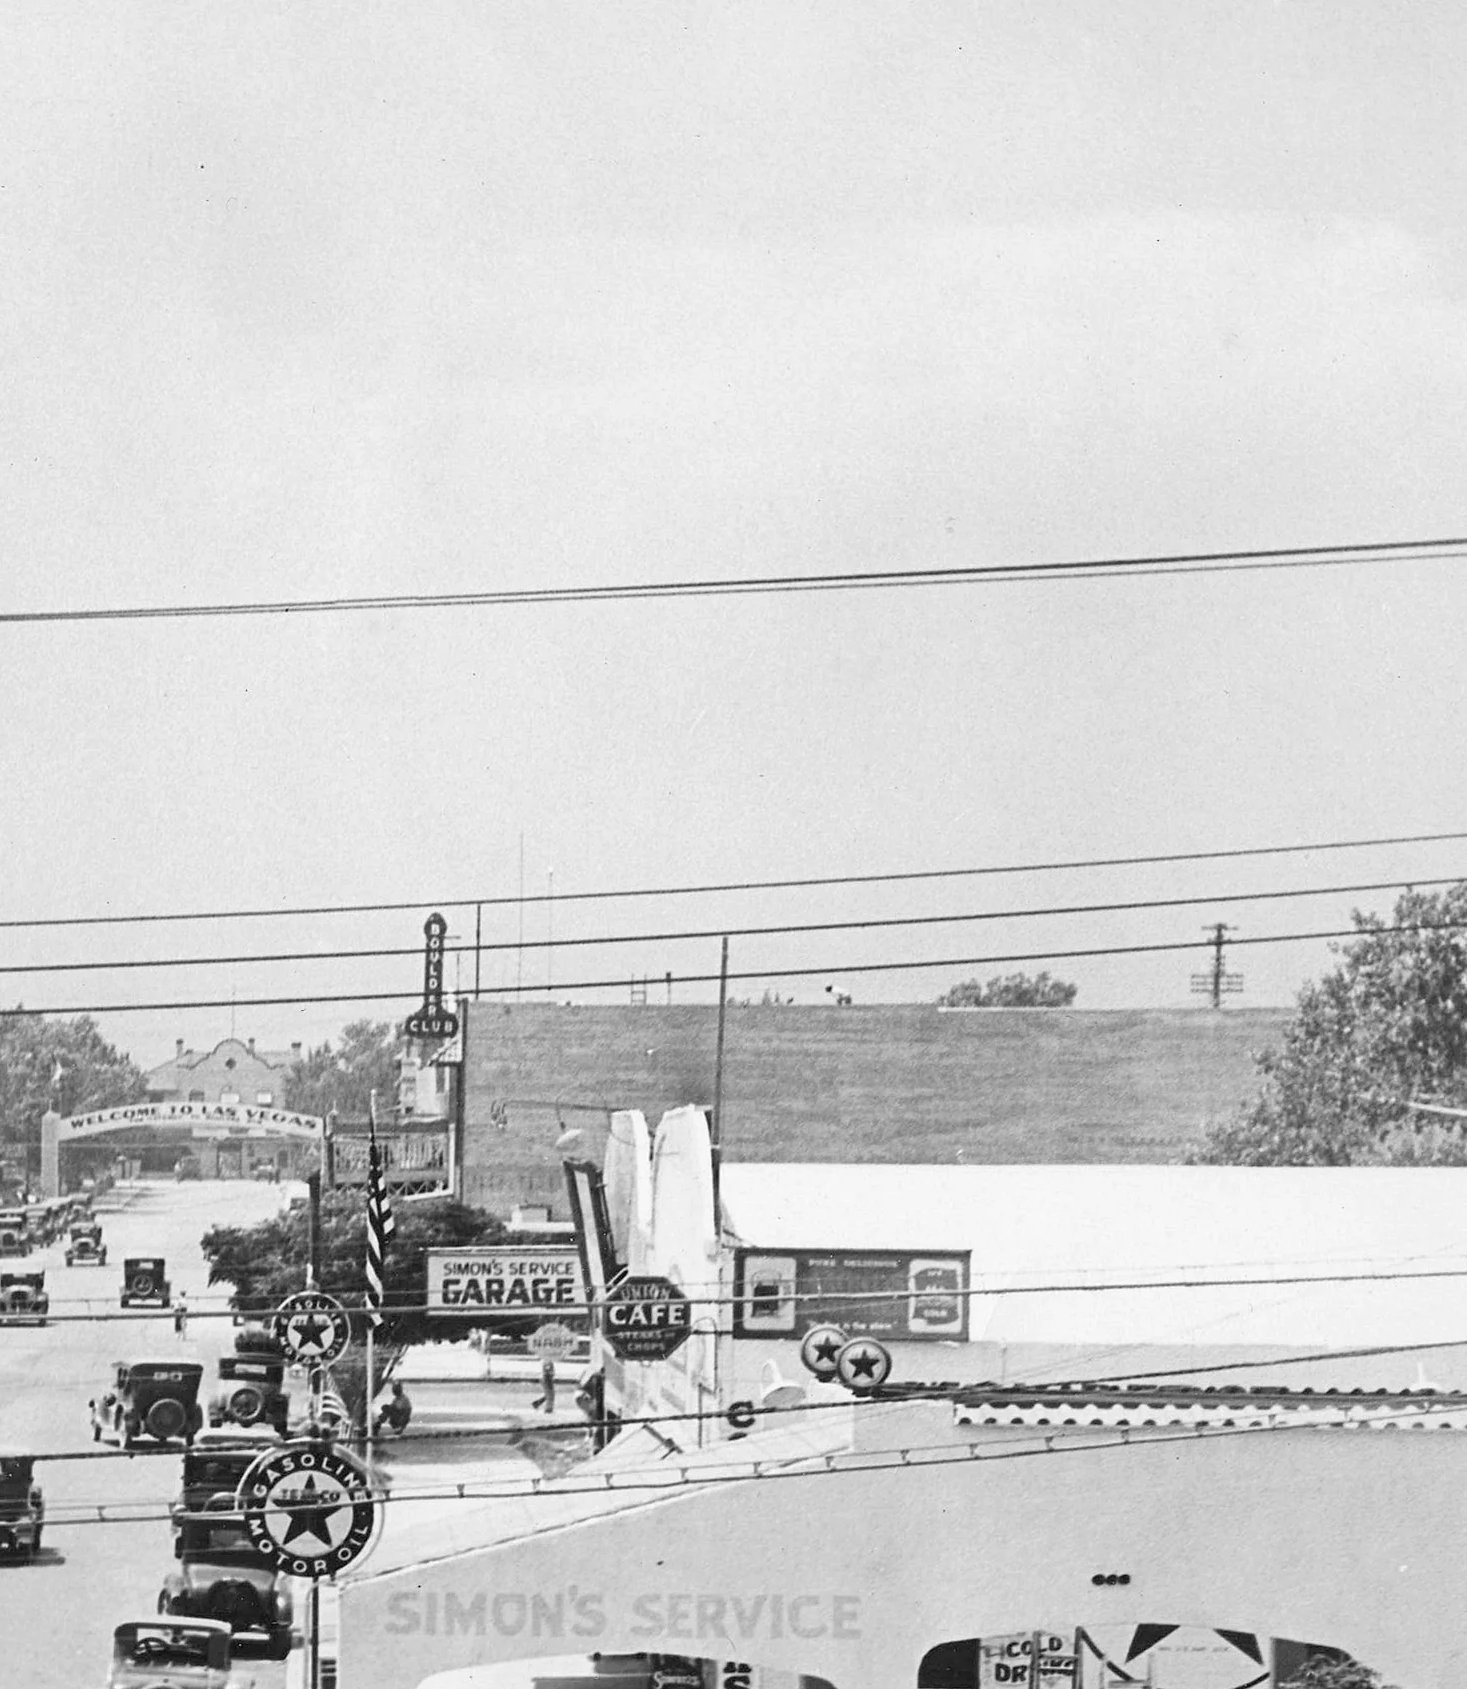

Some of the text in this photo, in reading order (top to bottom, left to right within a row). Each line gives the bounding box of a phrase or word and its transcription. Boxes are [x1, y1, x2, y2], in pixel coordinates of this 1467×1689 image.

[428, 923, 440, 1016] BOULDER
[409, 1020, 453, 1033] CLUB
[70, 1107, 156, 1129] WELCOME
[170, 1104, 194, 1117] TO
[201, 1105, 237, 1118] LAS
[245, 1108, 317, 1130] VEGAS
[442, 1258, 575, 1277] SIMON'S SERVICE
[441, 1277, 576, 1306] GARAGE
[608, 1303, 685, 1326] CAFE
[253, 1453, 370, 1502] GASOLINE
[248, 1519, 369, 1573] MOTOR OIL
[383, 1584, 864, 1639] SIMON'S SERVICE
